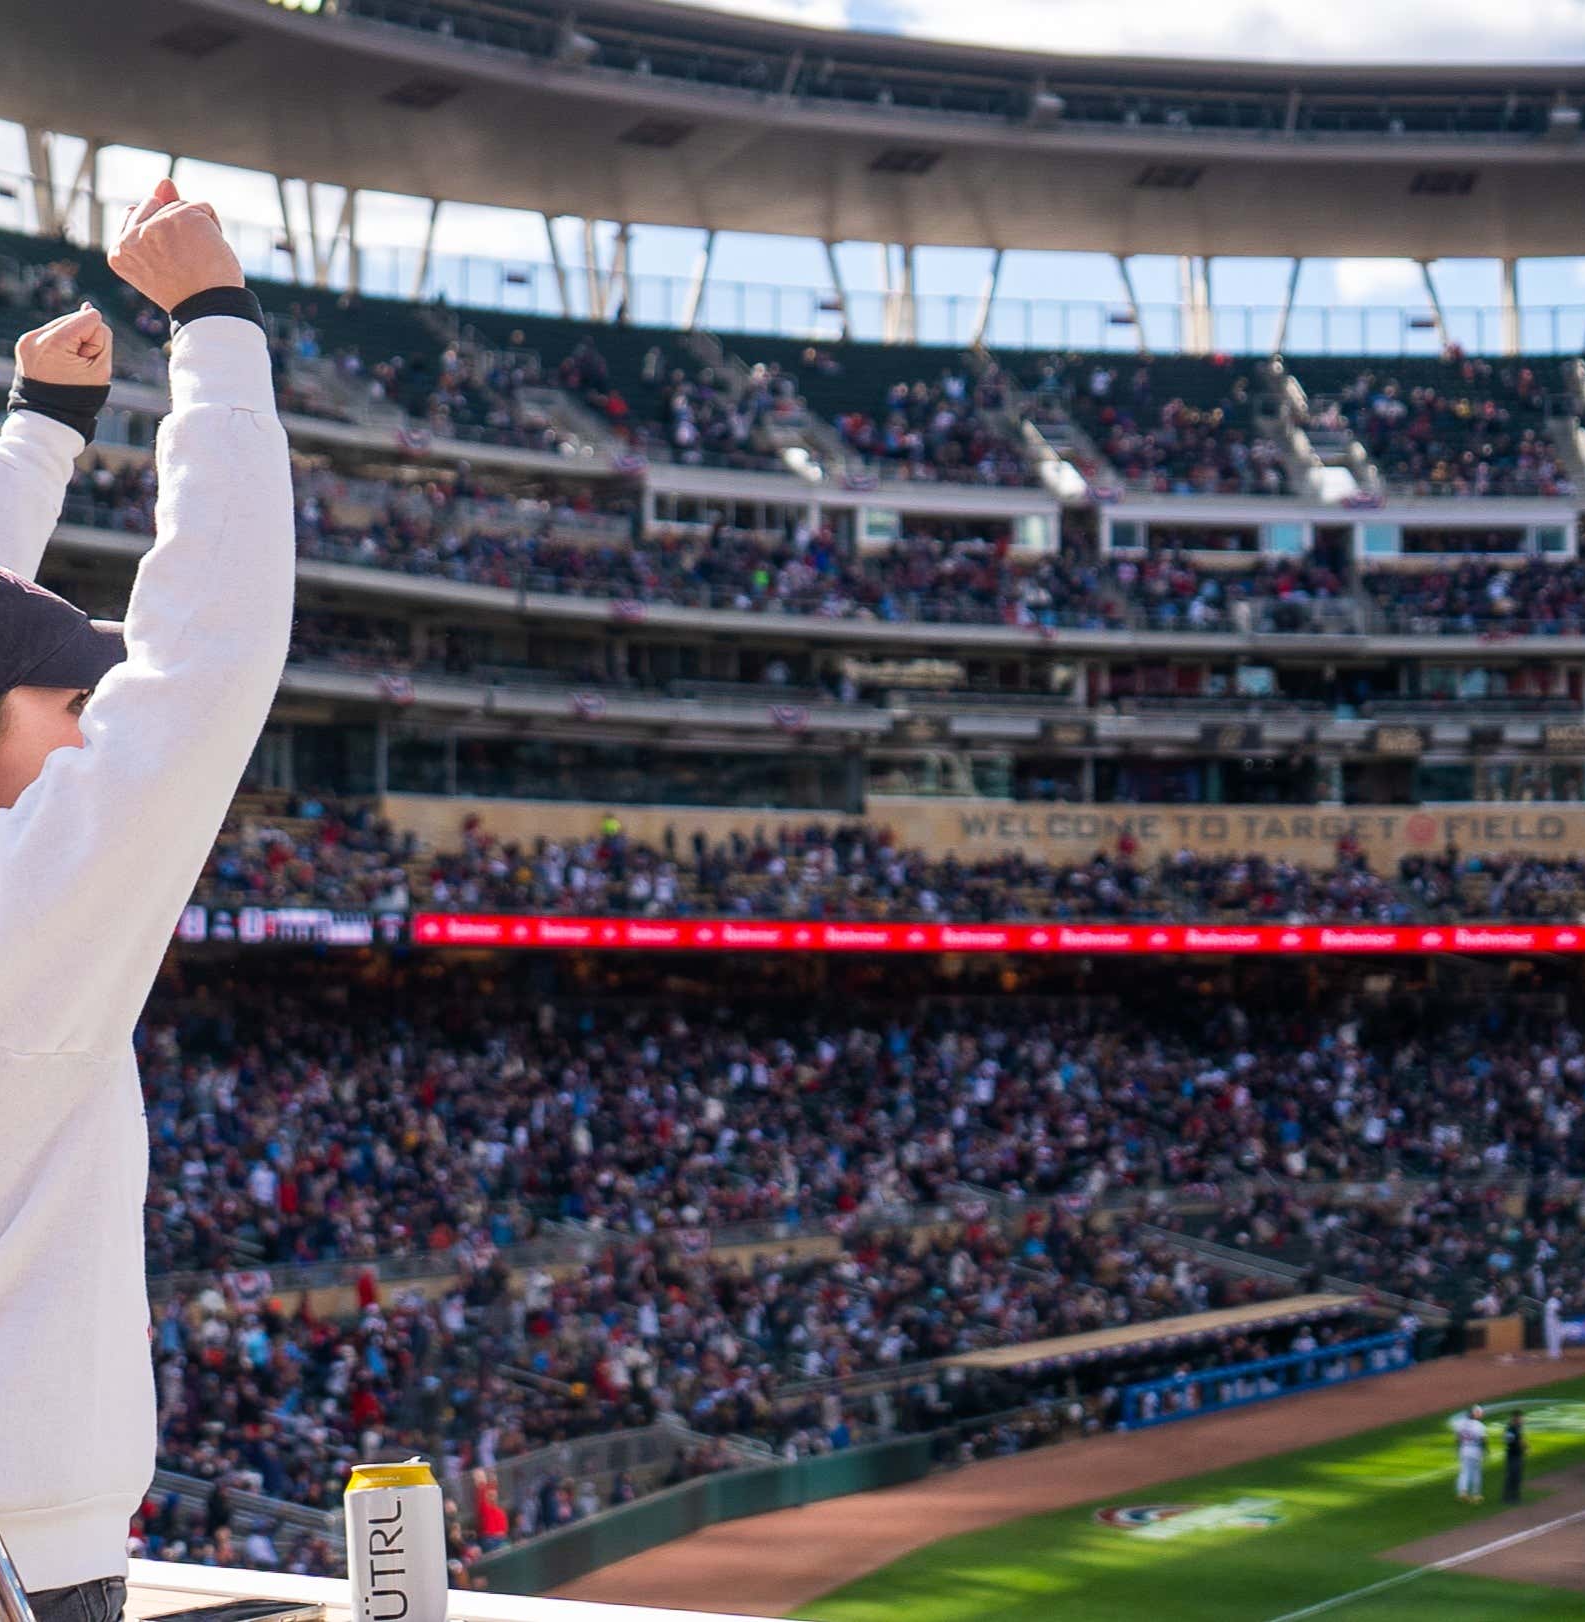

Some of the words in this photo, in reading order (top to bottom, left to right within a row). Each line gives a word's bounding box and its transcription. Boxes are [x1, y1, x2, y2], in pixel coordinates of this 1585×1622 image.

[960, 812, 1162, 839] WELCOME
[1174, 814, 1230, 840] TO
[1242, 814, 1399, 841] TARGET
[1443, 814, 1565, 841] FIELD
